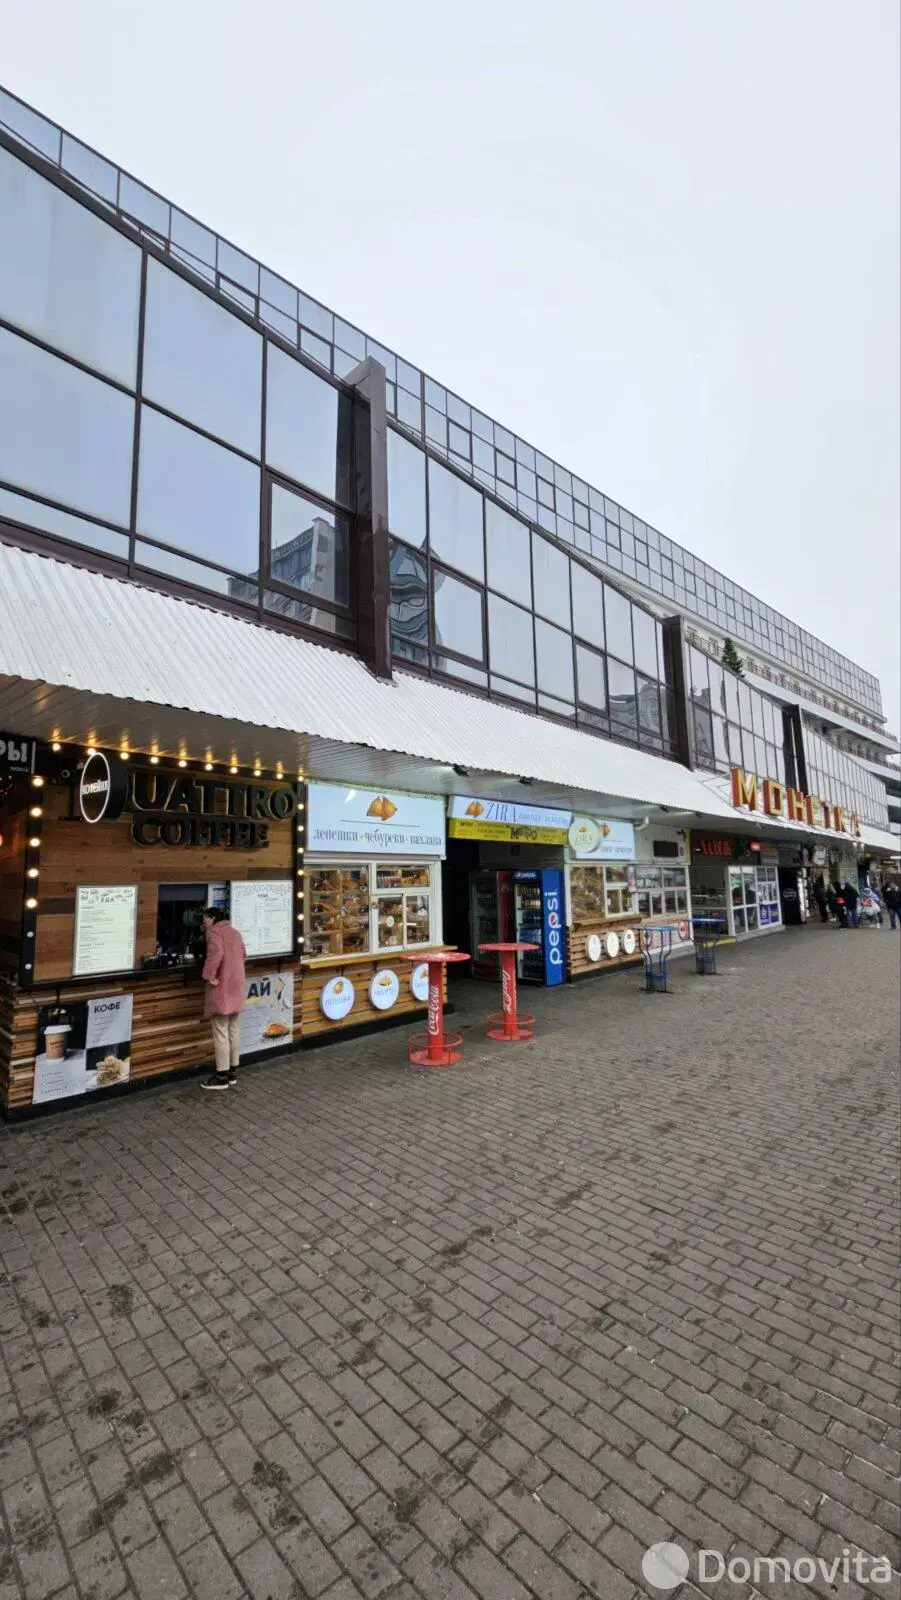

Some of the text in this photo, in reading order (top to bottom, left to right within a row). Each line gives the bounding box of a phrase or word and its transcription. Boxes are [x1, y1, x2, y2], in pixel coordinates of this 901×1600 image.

[485, 802, 516, 822] ZIRA
[730, 767, 861, 837] МОНЕТКА
[132, 816, 270, 848] COFFEE
[313, 828, 442, 847] лепешки чебуреки пахлава
[544, 889, 563, 965] pepsi
[94, 1002, 121, 1014] КОФЕ
